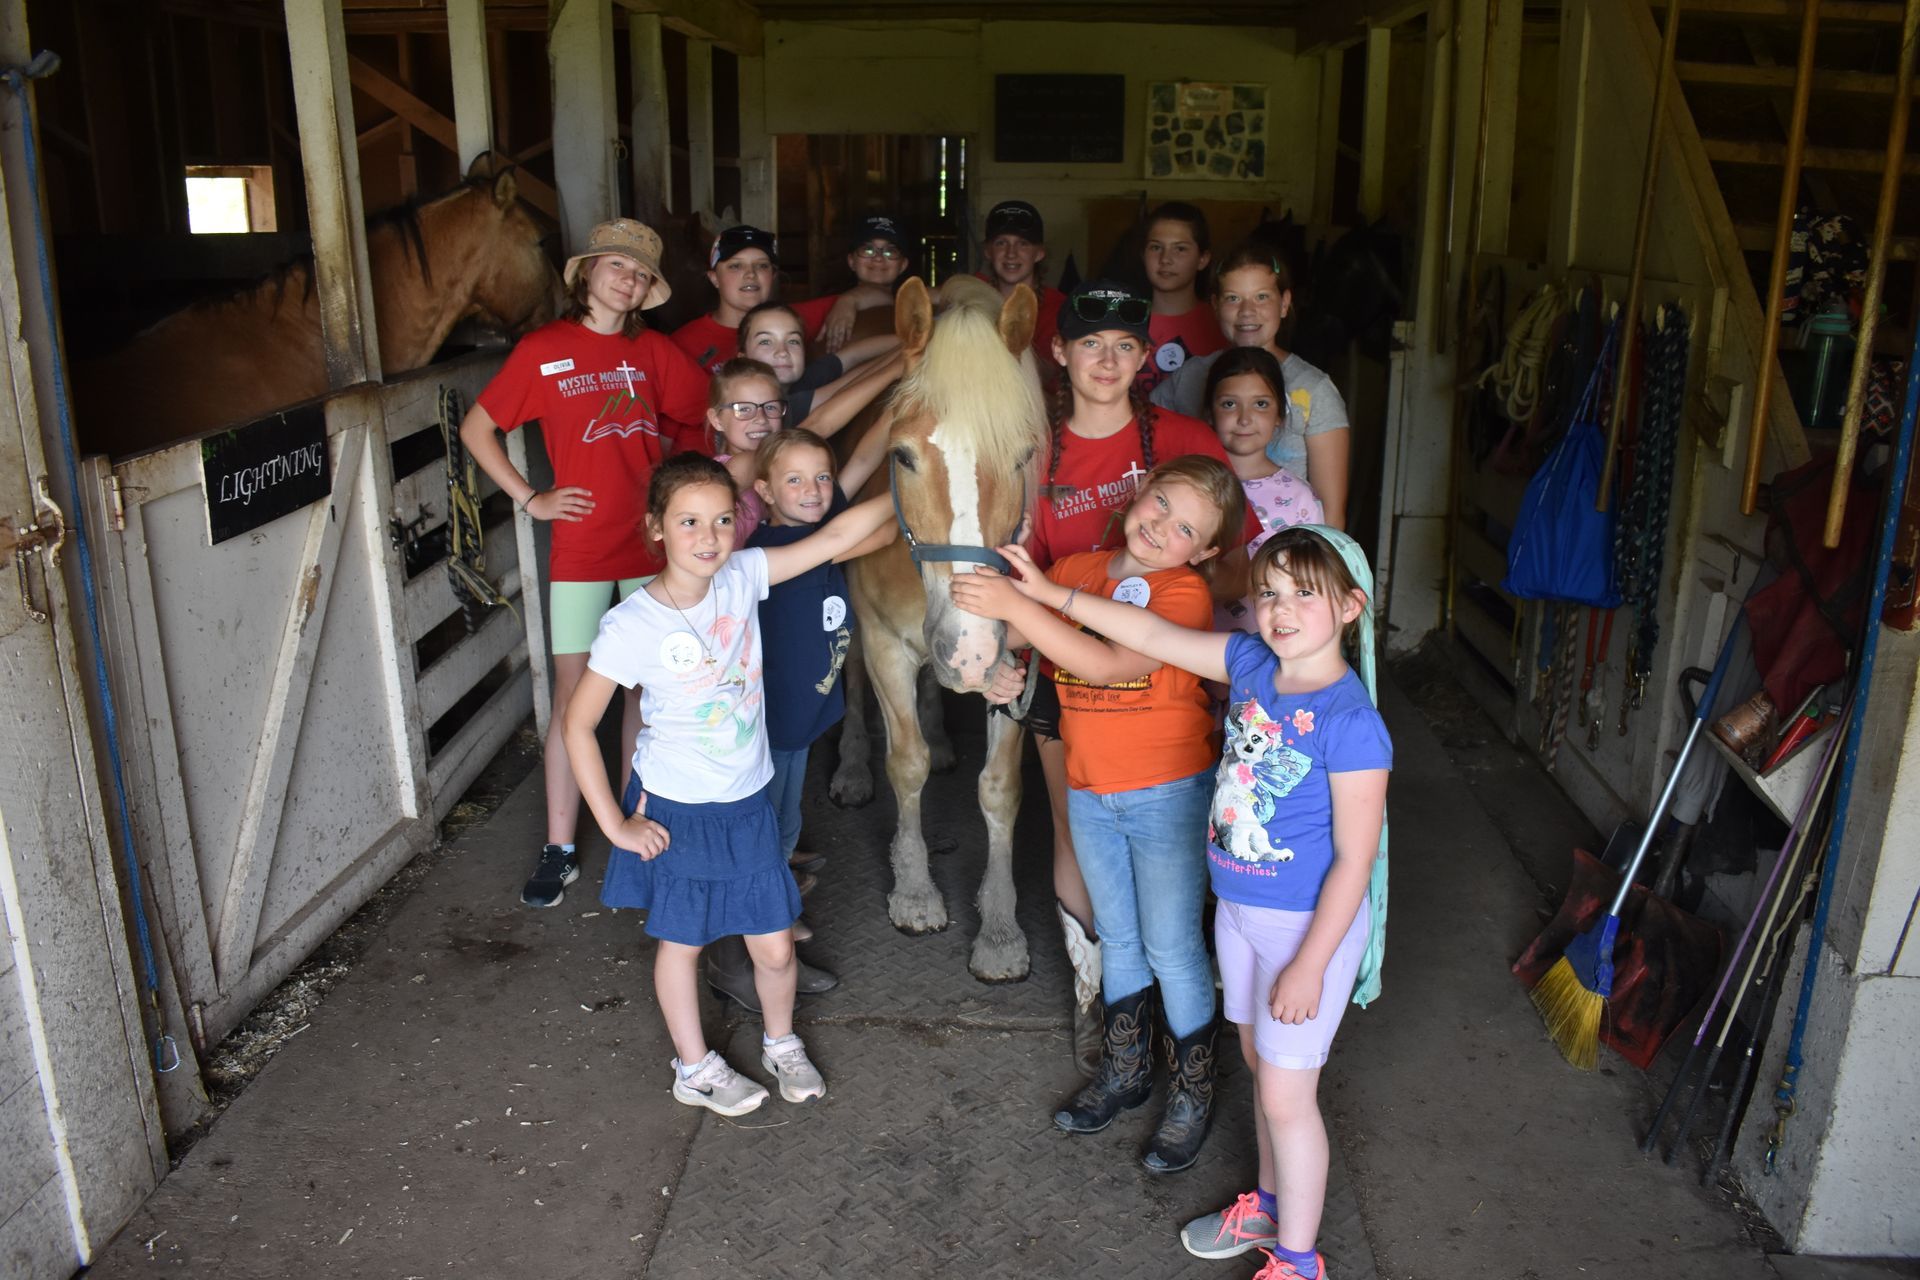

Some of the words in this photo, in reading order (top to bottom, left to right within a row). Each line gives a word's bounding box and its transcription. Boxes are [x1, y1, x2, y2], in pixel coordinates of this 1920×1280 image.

[557, 373, 596, 392] MYSTIC
[562, 386, 599, 398] TRAINING
[601, 383, 630, 391] CENTER
[219, 442, 323, 506] LIGHTNING
